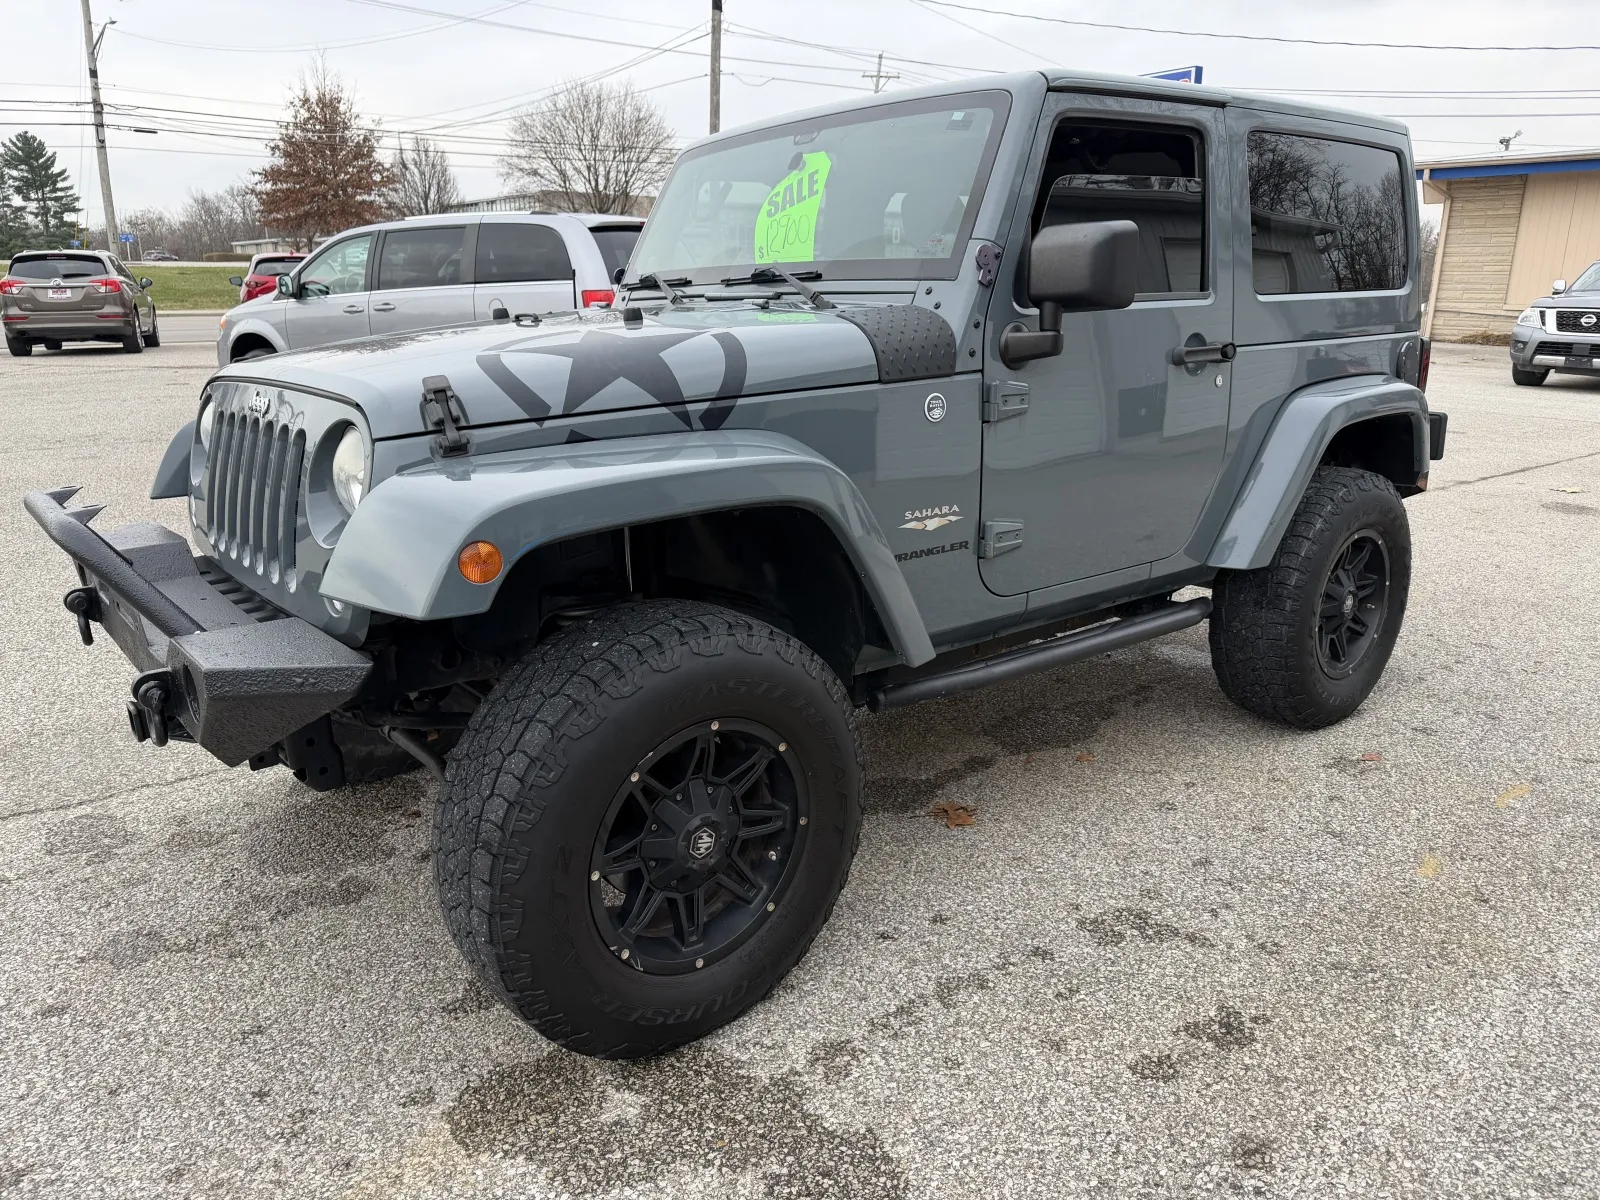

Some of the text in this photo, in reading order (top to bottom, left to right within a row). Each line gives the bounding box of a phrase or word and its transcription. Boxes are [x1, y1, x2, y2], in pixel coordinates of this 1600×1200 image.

[766, 168, 819, 218] SALE
[248, 390, 270, 418] Jeep
[904, 504, 960, 520] SAHARA
